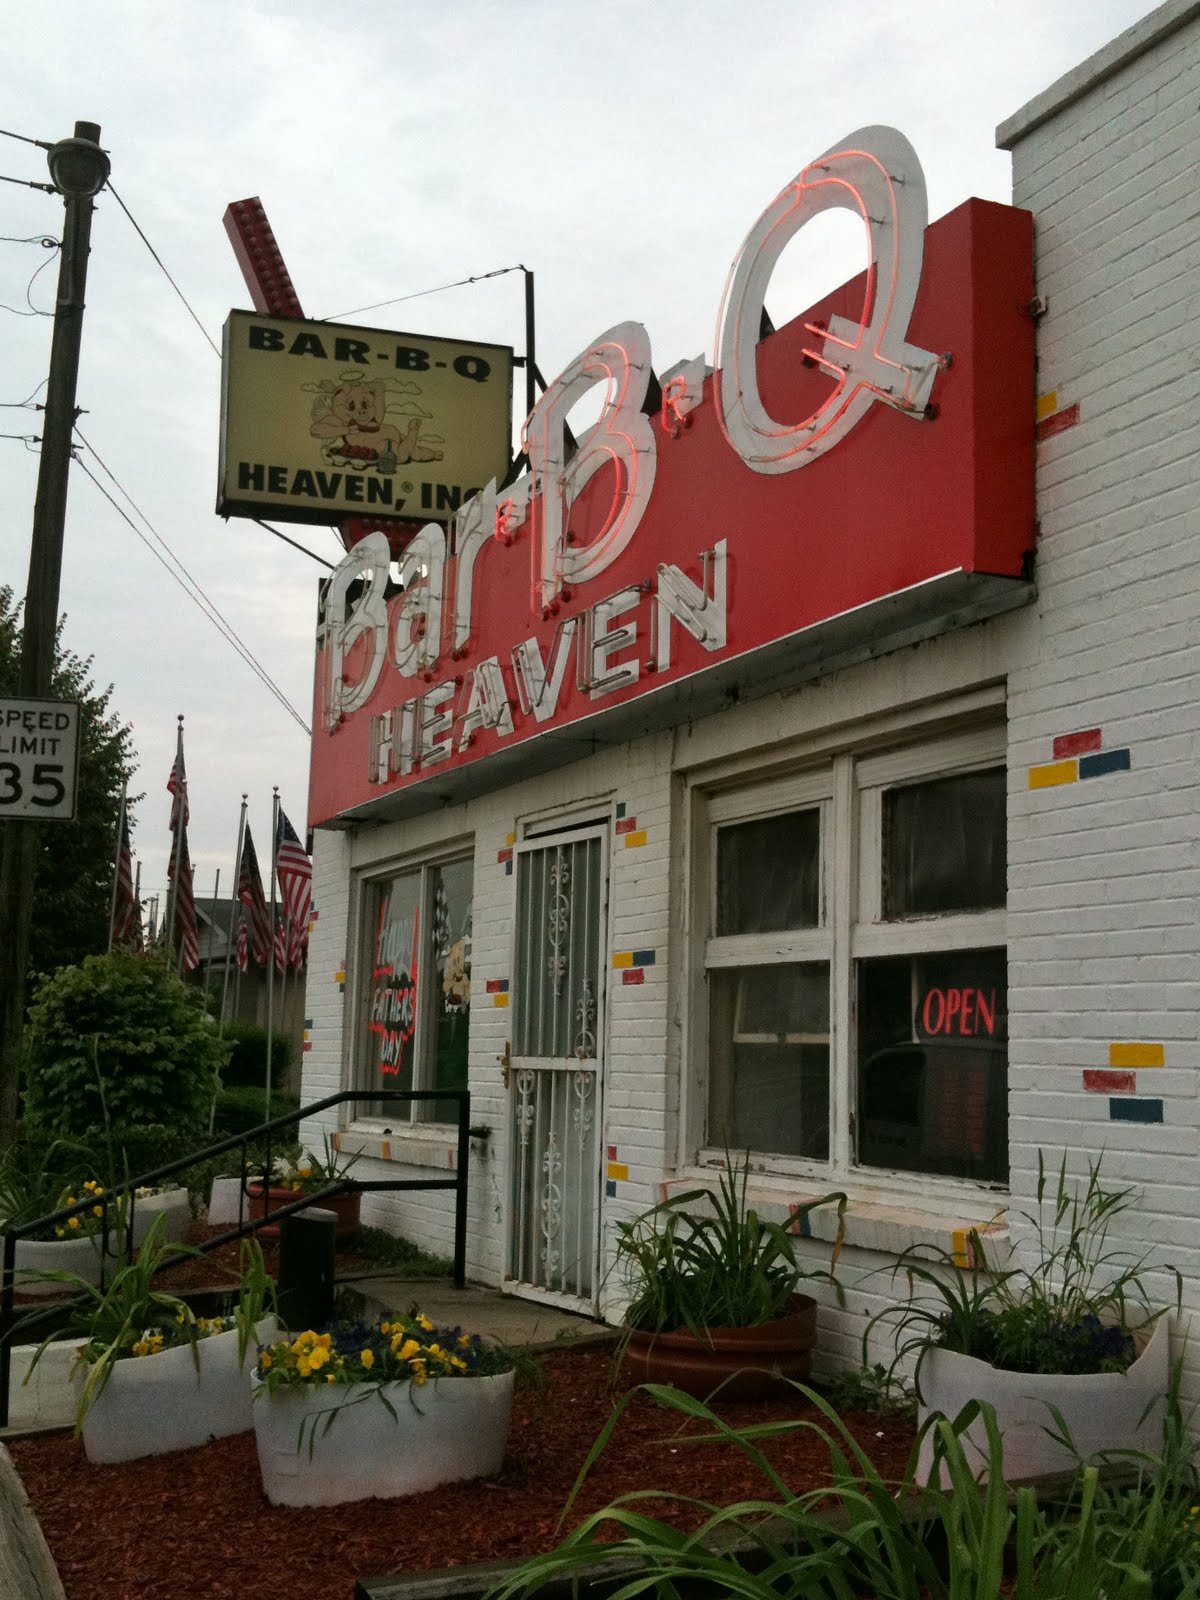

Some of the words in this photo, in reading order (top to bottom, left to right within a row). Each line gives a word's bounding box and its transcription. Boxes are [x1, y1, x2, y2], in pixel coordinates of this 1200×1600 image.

[249, 326, 491, 382] BAR-B-Q
[368, 538, 727, 784] HEAVEN
[0, 709, 70, 730] PEED
[0, 762, 65, 807] 35
[923, 988, 996, 1035] OPEN
